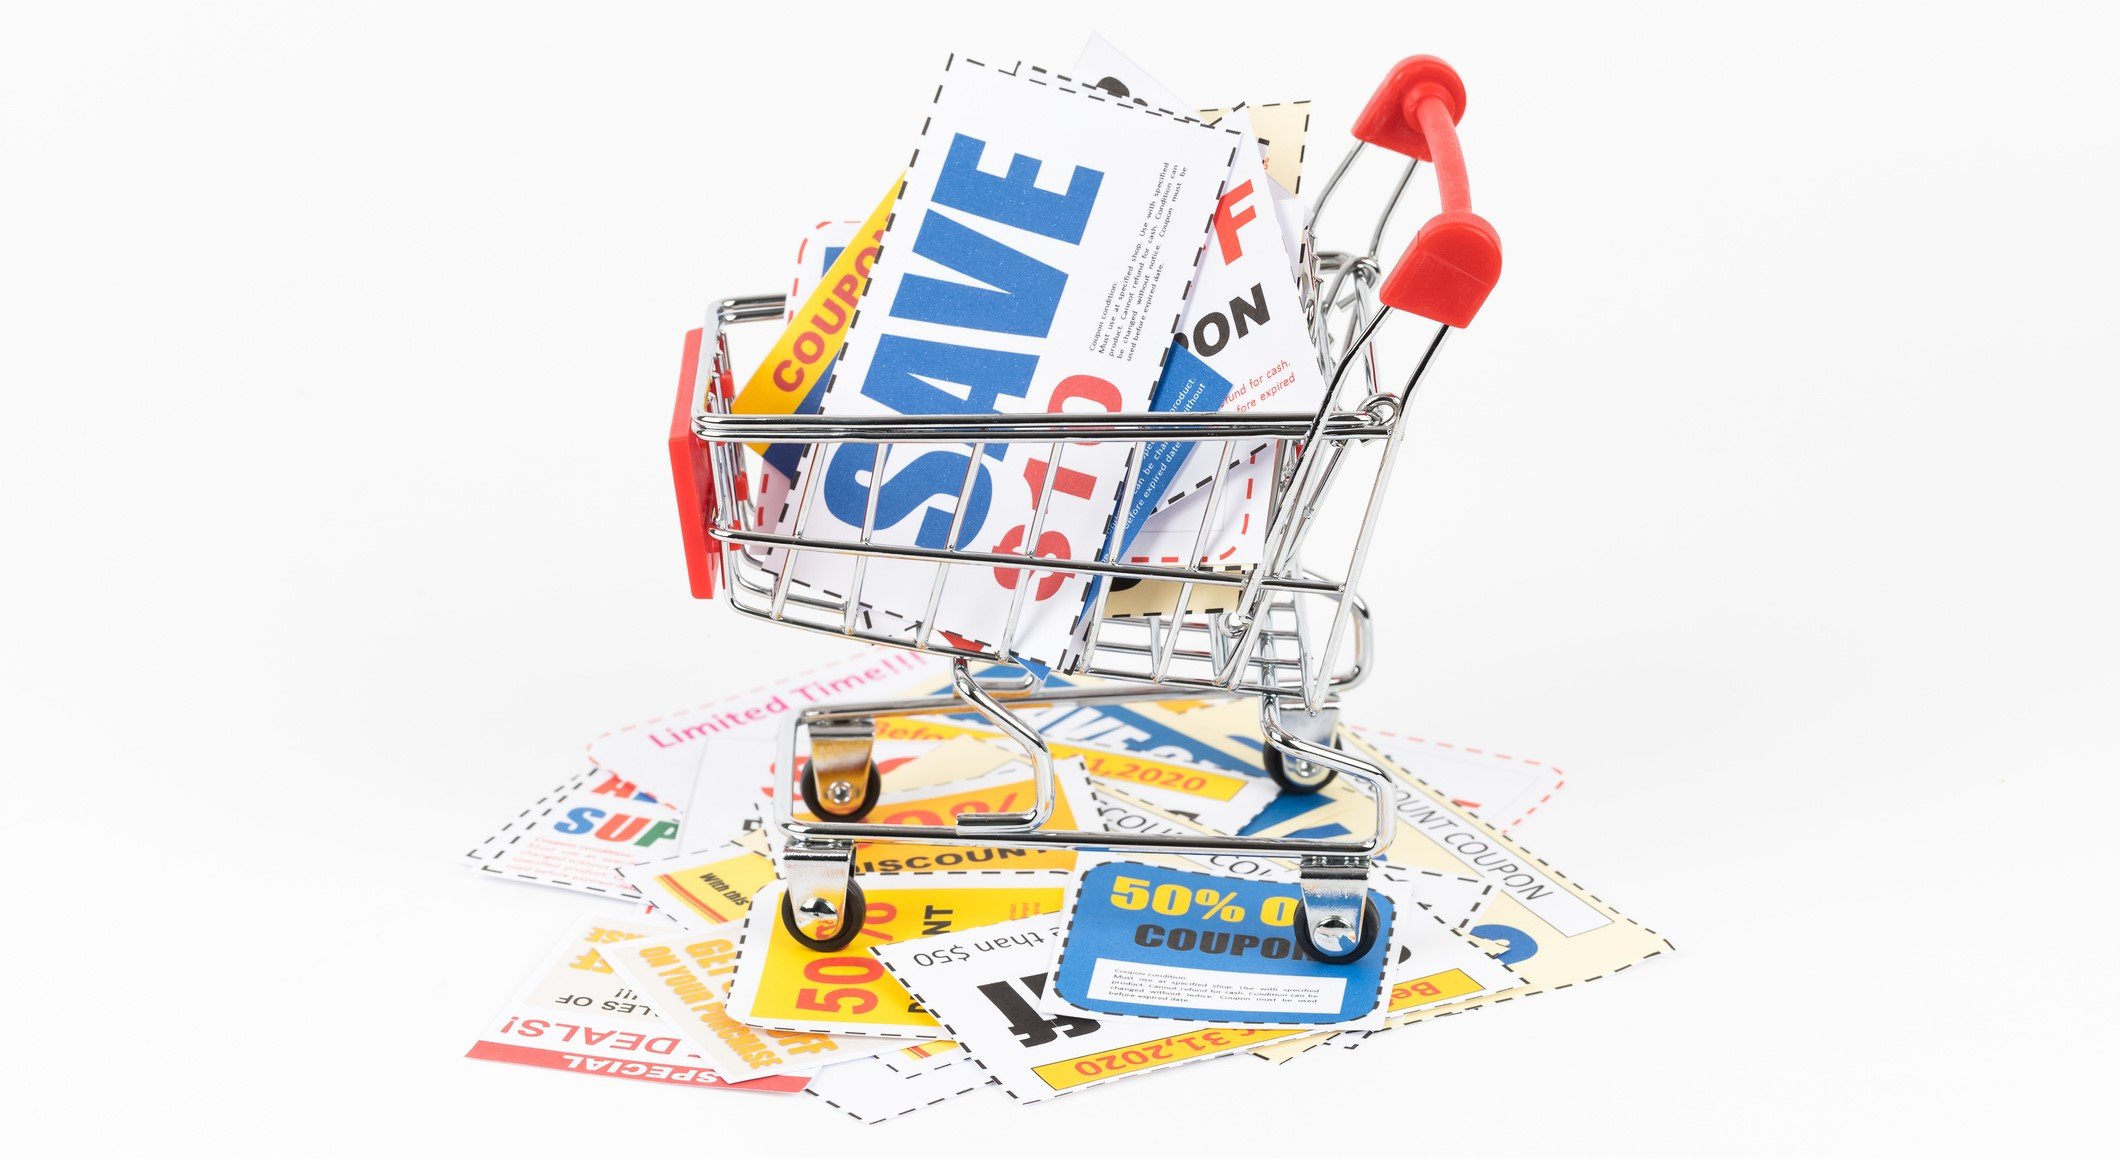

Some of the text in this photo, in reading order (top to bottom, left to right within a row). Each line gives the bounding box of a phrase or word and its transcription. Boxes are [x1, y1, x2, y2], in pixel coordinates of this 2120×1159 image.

[1098, 162, 1170, 354] Must use at specified shop. Use with specified
[1108, 164, 1179, 357] product. Cannot refund for cash. Condition can
[1116, 166, 1187, 359] be changed without notice. Coupon must be
[824, 132, 1105, 551] SAVE
[1089, 321, 1104, 352] Coupon
[1126, 342, 1137, 362] used
[1132, 315, 1146, 341] before
[1143, 283, 1157, 313] expired
[1249, 375, 1265, 394] for
[1266, 359, 1291, 380] cash.
[1260, 375, 1295, 402] expired
[991, 374, 1123, 601] $10
[1143, 462, 1154, 475] be
[1143, 463, 1167, 499] expired
[648, 651, 927, 749] Limited Time!!!
[1445, 833, 1553, 901] COUPON
[1110, 875, 1245, 923] 50%
[639, 945, 681, 968] ON
[913, 945, 970, 967] $50
[975, 931, 1045, 951] than
[658, 965, 714, 1005] YOUR
[555, 995, 659, 1017] LES OF
[500, 1016, 682, 1055] DEALS!
[1074, 1031, 1231, 1077] 31,2020
[563, 1054, 718, 1084] SPECIAL
